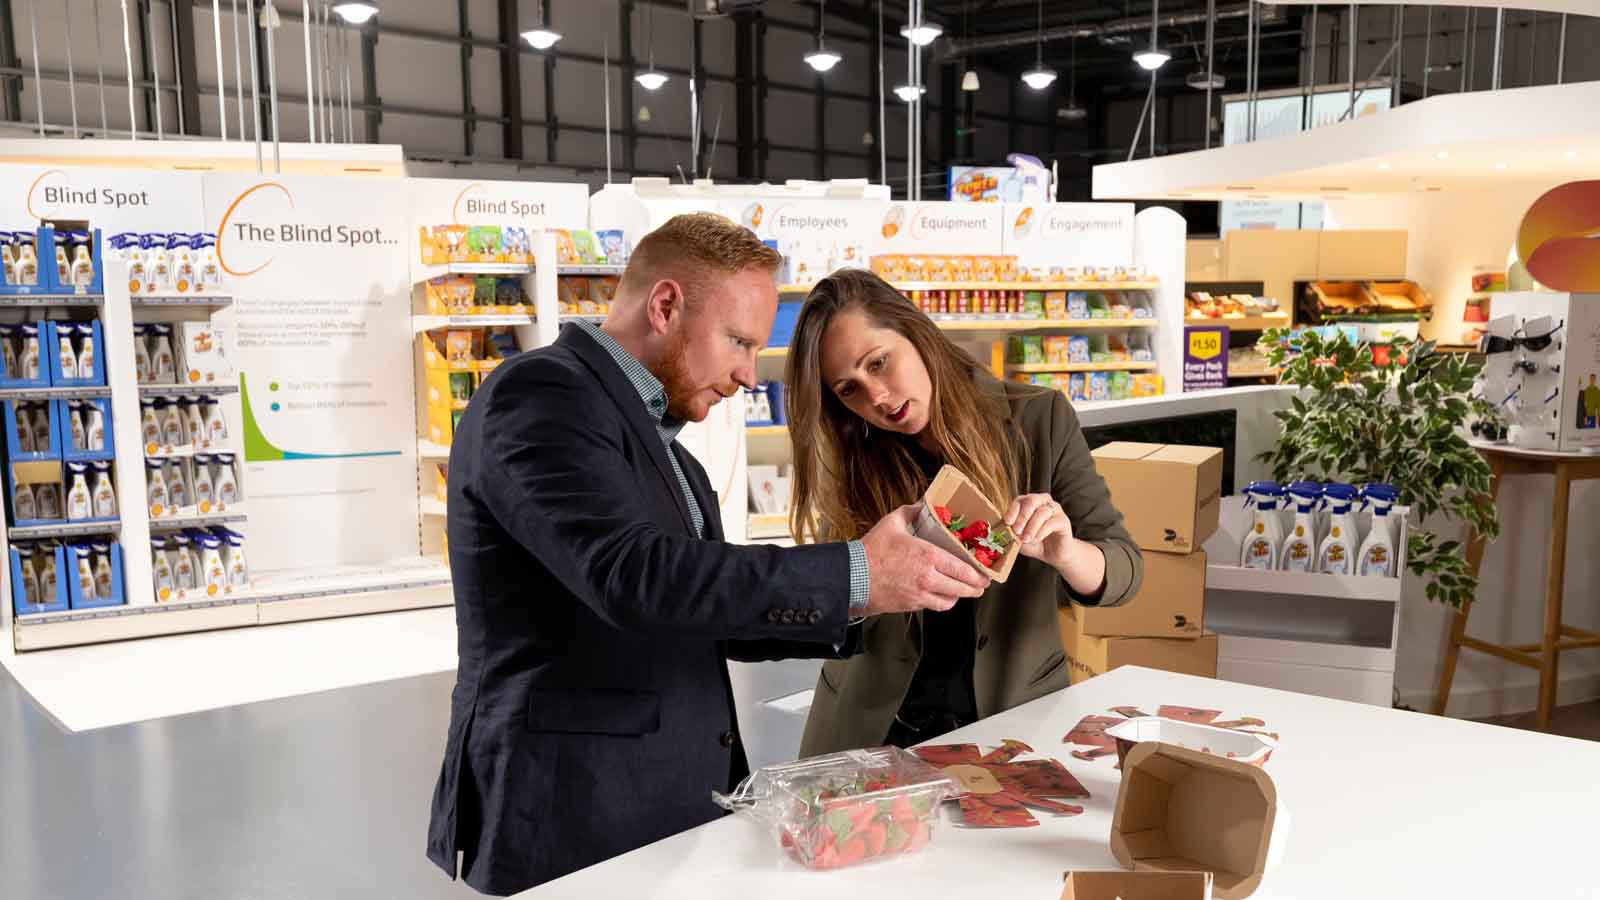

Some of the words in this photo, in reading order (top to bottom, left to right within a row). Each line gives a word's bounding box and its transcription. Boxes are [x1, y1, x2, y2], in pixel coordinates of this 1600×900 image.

[44, 186, 97, 205] Blind
[101, 187, 149, 209] Spot
[466, 199, 507, 214] Blind
[510, 199, 546, 217] Spot
[778, 214, 849, 232] Employees
[920, 214, 988, 232] Equipment
[1049, 215, 1123, 233] Engagement
[233, 223, 276, 243] The
[279, 223, 333, 244] Blind
[336, 224, 399, 248] Spot...
